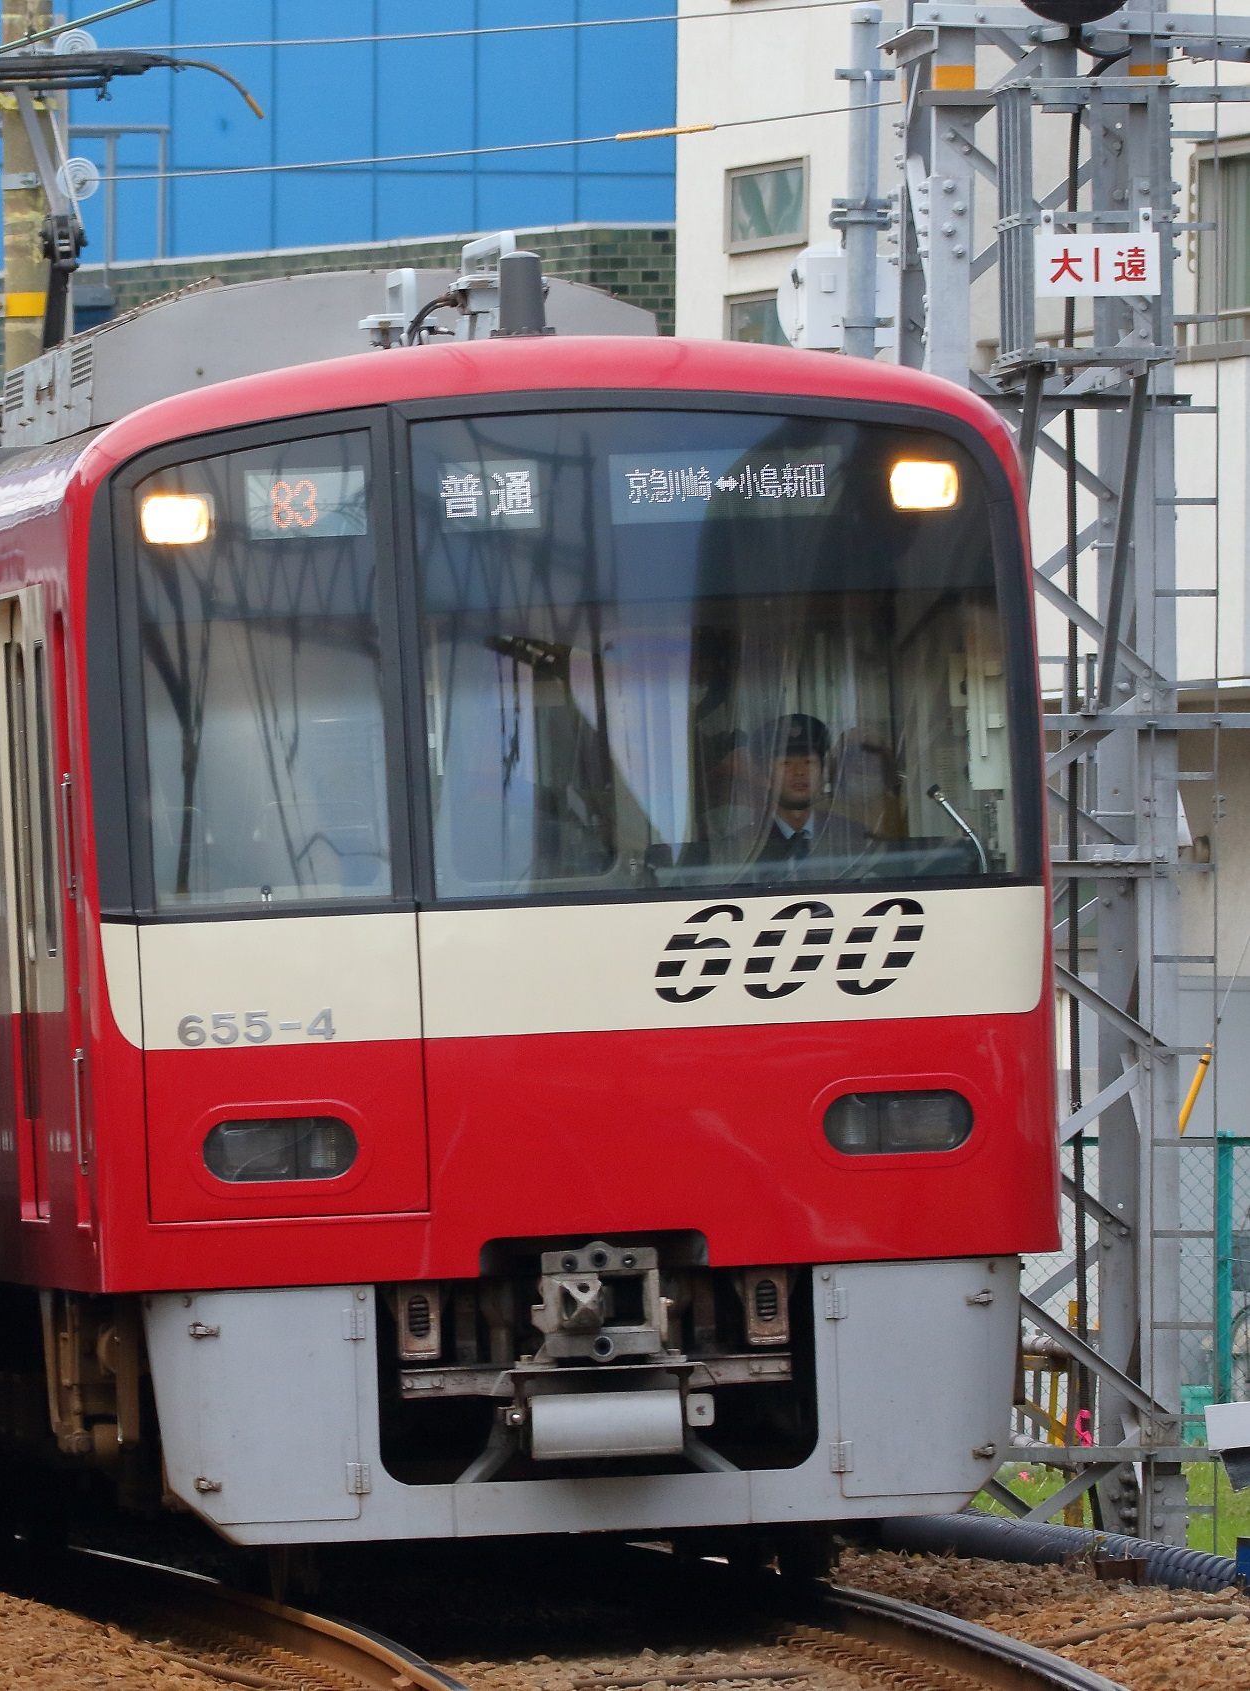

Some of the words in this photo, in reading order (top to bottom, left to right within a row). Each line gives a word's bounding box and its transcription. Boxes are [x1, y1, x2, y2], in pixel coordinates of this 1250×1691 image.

[270, 479, 319, 529] 83
[440, 470, 534, 519] 普通
[654, 897, 925, 1004] 600
[177, 1007, 336, 1047] 655-4
